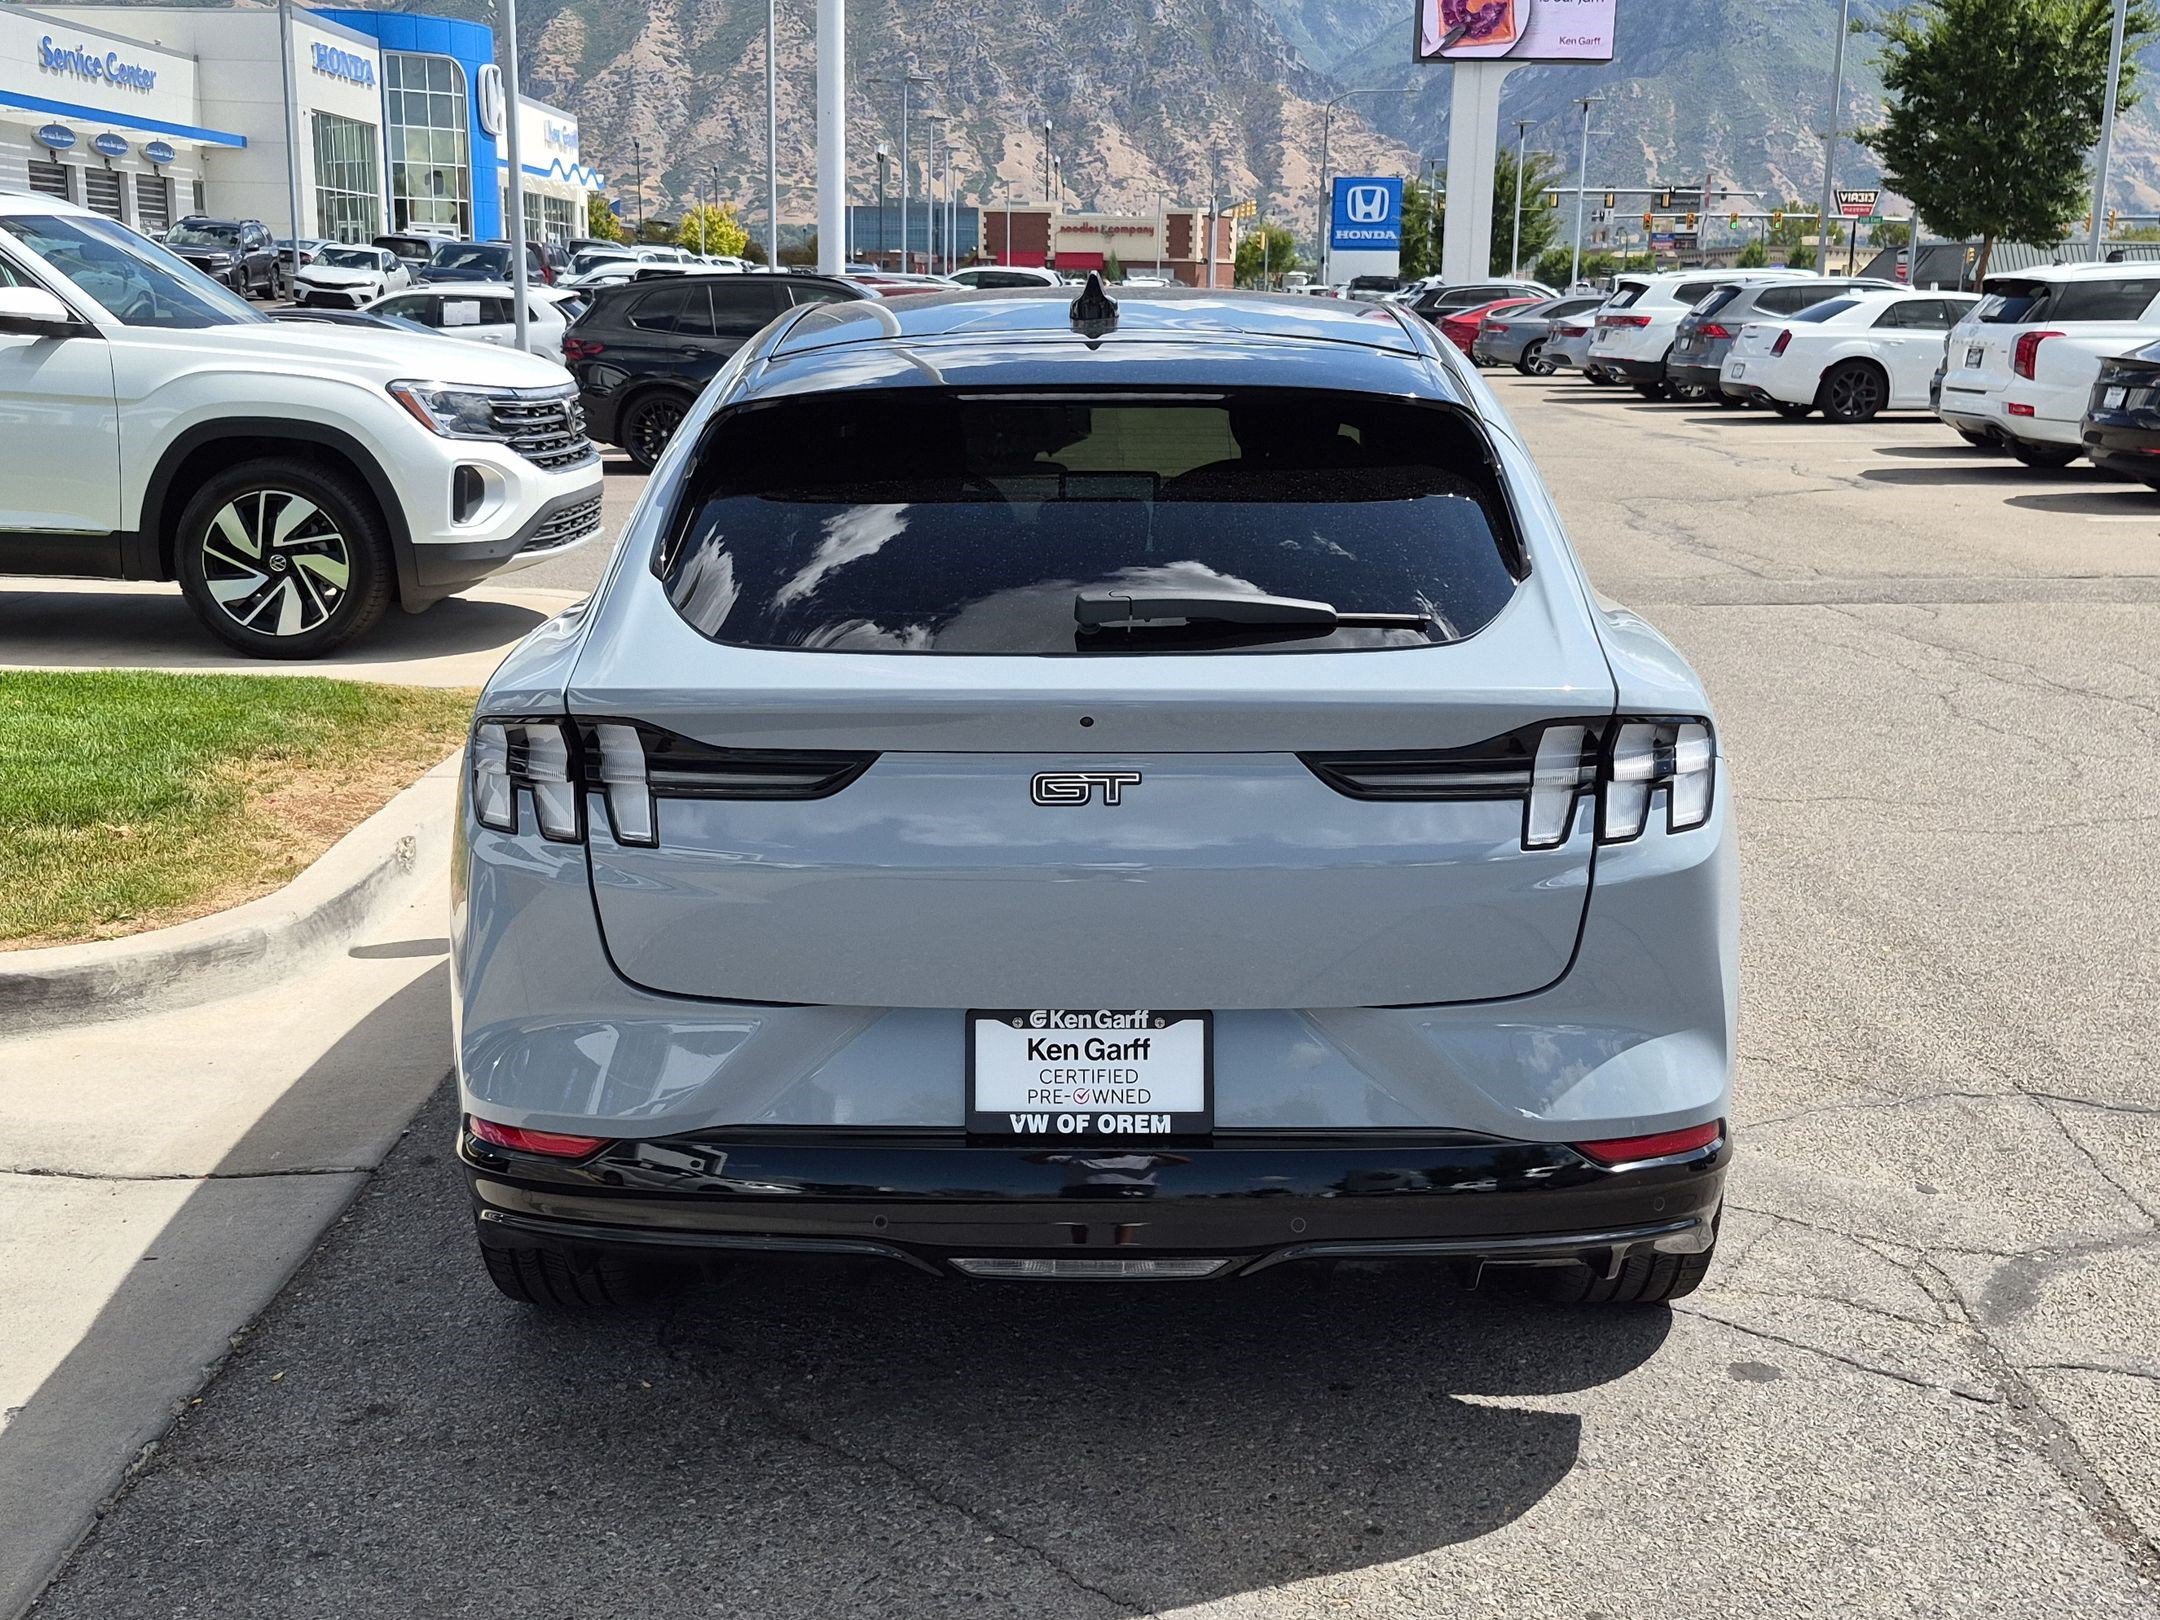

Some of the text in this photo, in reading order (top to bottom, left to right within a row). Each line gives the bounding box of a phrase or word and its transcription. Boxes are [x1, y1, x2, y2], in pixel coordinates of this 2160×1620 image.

[1559, 36, 1601, 46] Ken Garff
[41, 35, 157, 89] Service Center
[312, 42, 376, 85] HONDA
[1060, 222, 1099, 234] noodles
[1108, 226, 1155, 238] company
[1335, 230, 1397, 240] HONDA
[1030, 771, 1142, 806] GT
[1050, 1009, 1149, 1029] Ken Garff
[1027, 1037, 1151, 1061] Ken Garff
[1039, 1068, 1139, 1085] CERTIFIED
[1009, 1113, 1172, 1134] VW OF OREM
